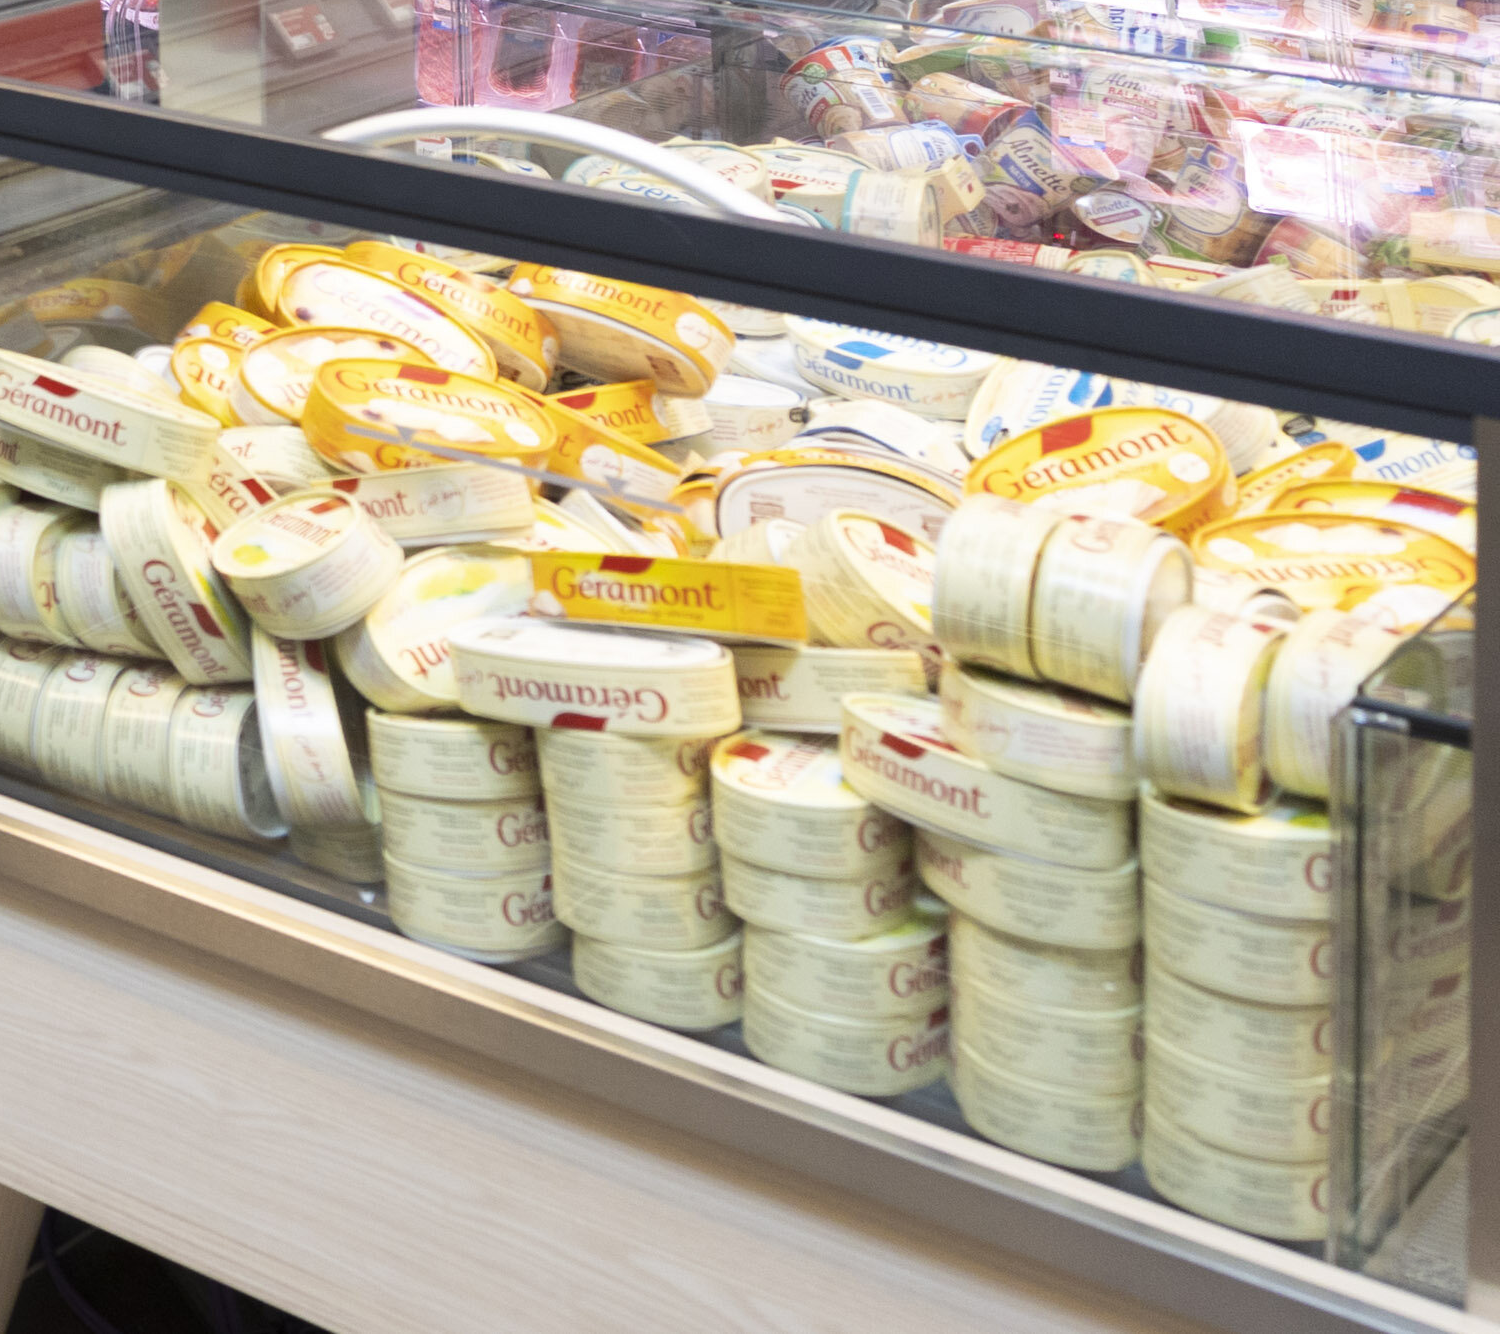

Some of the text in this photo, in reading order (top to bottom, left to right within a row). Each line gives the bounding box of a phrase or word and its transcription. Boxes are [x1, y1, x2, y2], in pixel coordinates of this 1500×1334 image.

[396, 261, 538, 345] Géramont
[334, 366, 533, 422] Géramont
[795, 345, 919, 404] Géramont
[983, 419, 1195, 494] Géramont
[142, 557, 229, 684] Géramont
[551, 567, 725, 610] Géramont
[483, 669, 669, 722] Géramont
[846, 737, 991, 818] Géramont
